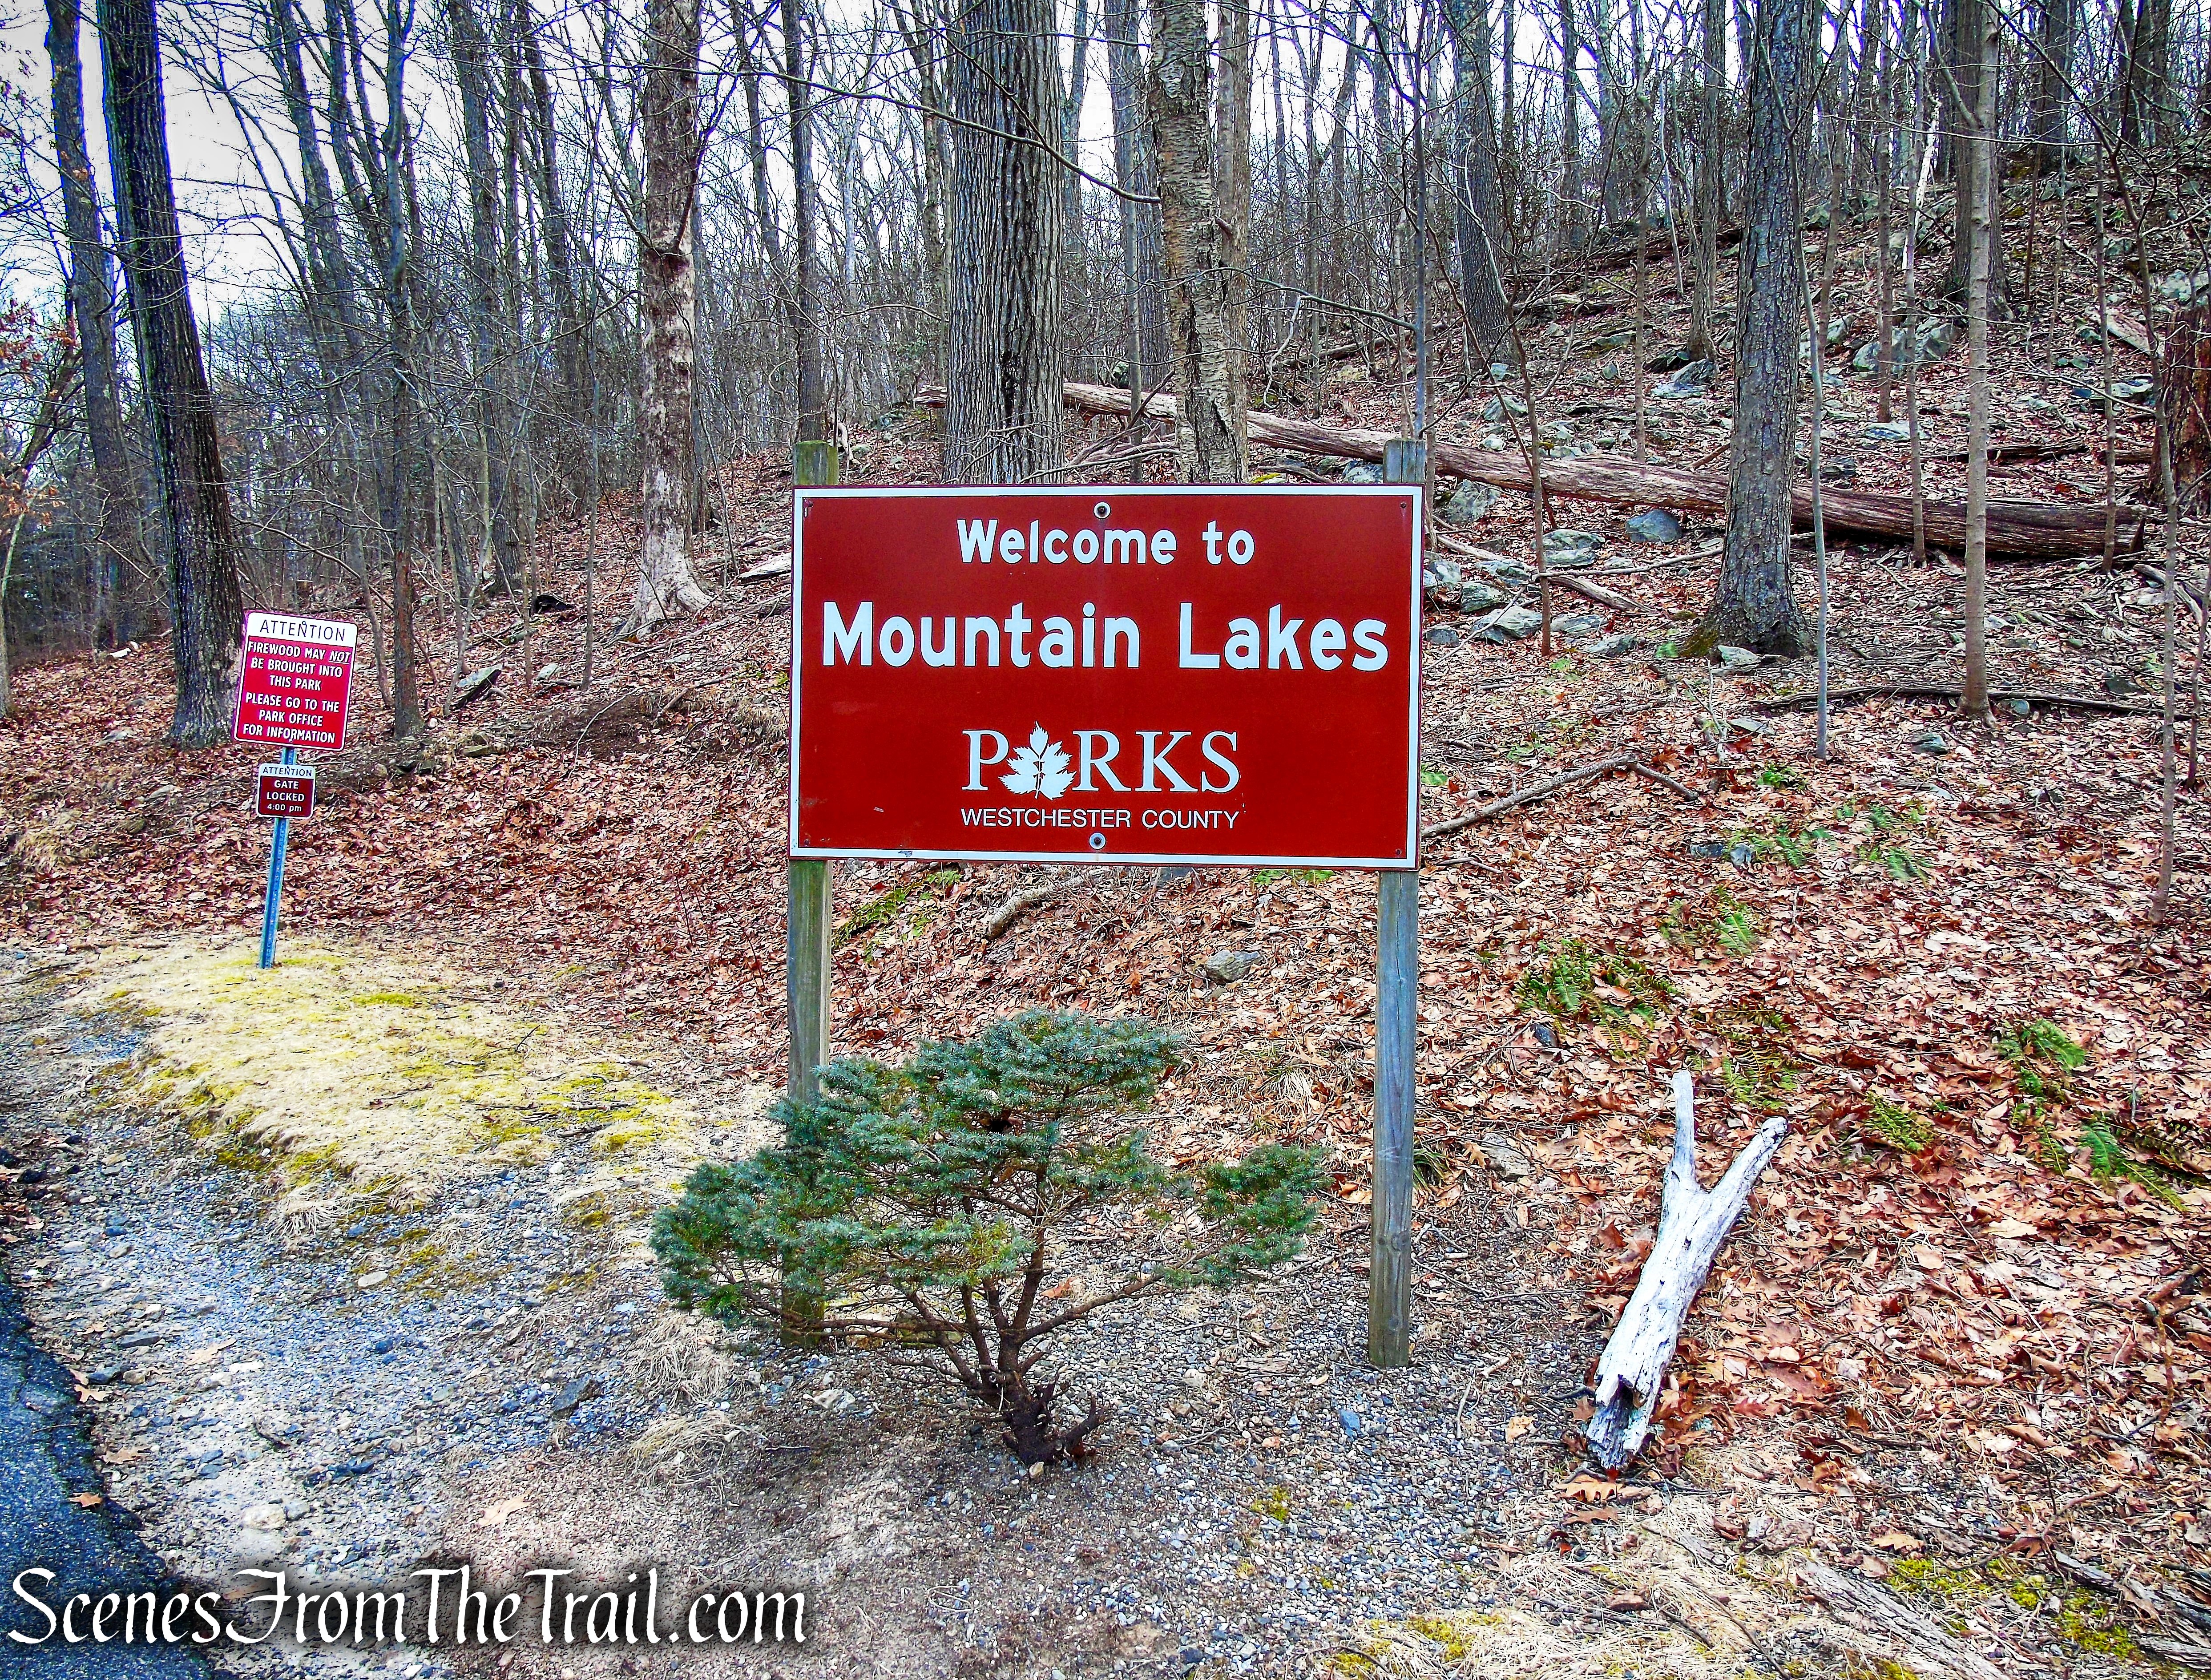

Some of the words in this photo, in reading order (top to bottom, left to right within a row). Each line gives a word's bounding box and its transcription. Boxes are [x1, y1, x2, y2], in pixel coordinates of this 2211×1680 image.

[957, 519, 1178, 564] Welcome
[1202, 520, 1255, 565] to
[260, 619, 345, 642] ATTENTION
[822, 601, 1140, 670] Mountain
[1178, 602, 1389, 671] Lakes
[248, 641, 300, 656] FIREWOOD
[305, 648, 326, 660] MAY
[329, 651, 351, 664] NOT
[251, 658, 264, 669] BE
[268, 659, 316, 674] BROUGHT
[319, 665, 342, 678] INTO
[270, 675, 291, 687] THIS
[295, 678, 322, 691] PARK
[246, 692, 282, 707] PLEASE
[286, 697, 300, 708] GO
[305, 699, 317, 710] TO
[322, 700, 339, 712] THE
[259, 710, 285, 722] PARK
[289, 713, 323, 726] OFFICE
[243, 724, 263, 736] FOR
[267, 726, 335, 743] INFORMATION
[263, 767, 311, 776] ATTENTION
[274, 780, 299, 789] GATE
[267, 792, 304, 801] LOCKED
[961, 808, 1131, 828] WESTCHESTER
[1142, 810, 1239, 829] COUNTY
